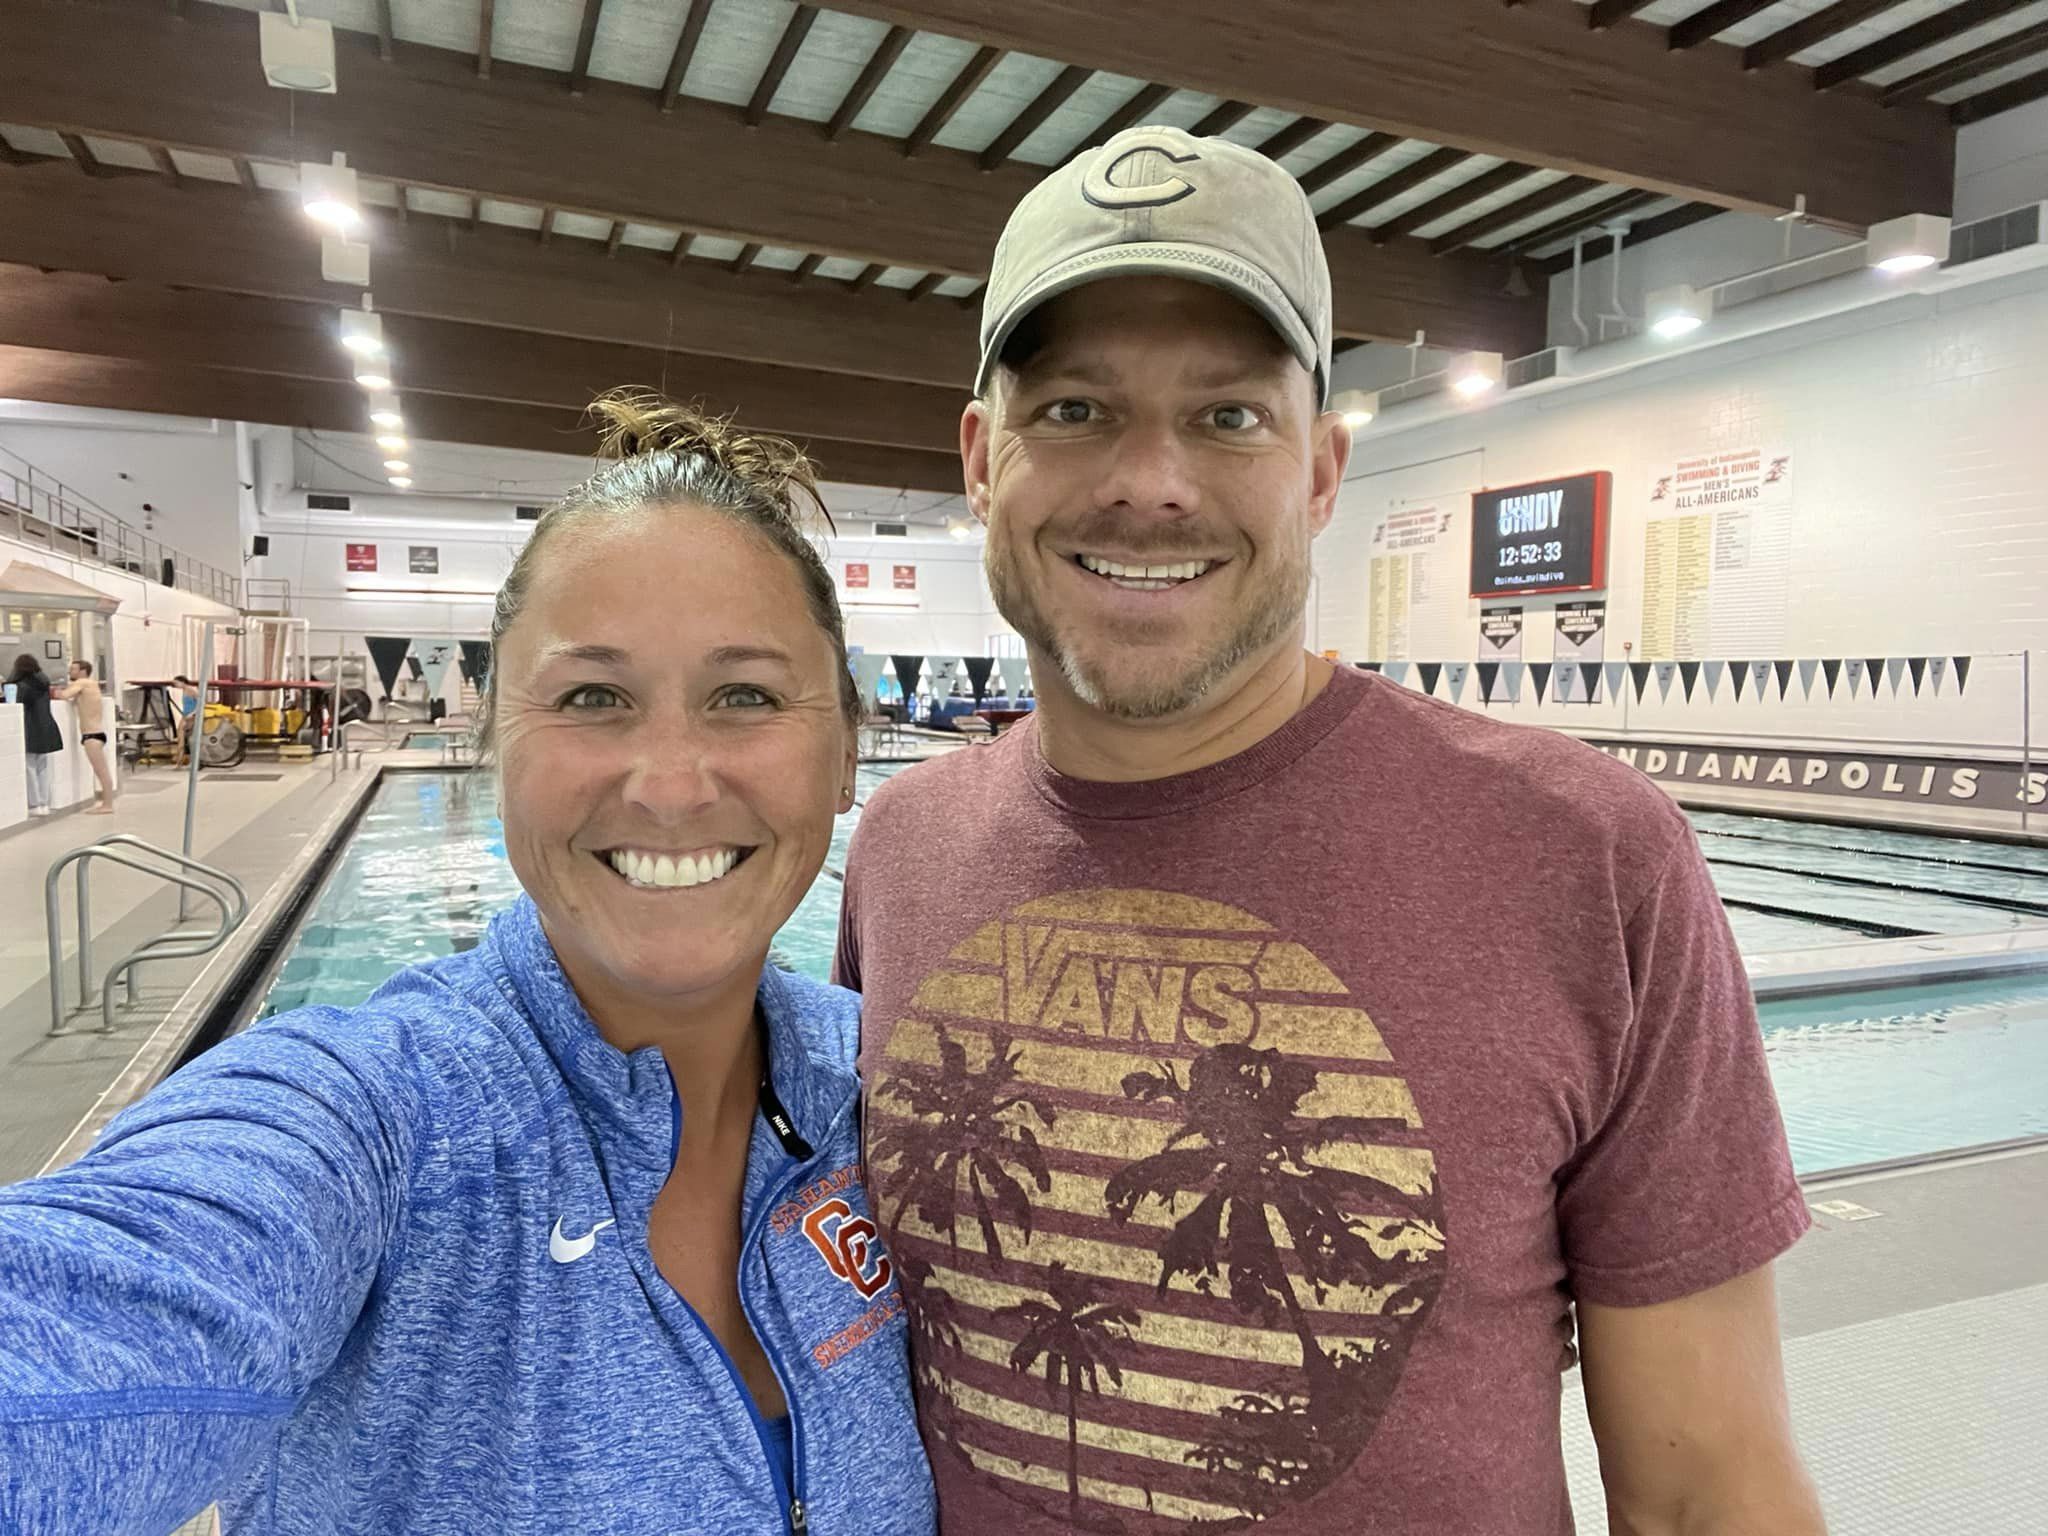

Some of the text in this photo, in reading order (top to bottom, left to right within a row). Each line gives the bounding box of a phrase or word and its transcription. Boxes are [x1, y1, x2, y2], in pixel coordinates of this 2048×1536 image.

[1082, 132, 1201, 210] C
[1731, 460, 1761, 475] DIVING
[1675, 486, 1760, 510] ALL-AMERICANS
[1601, 747, 1980, 799] NDIANAPOLIS
[1003, 917, 1260, 1049] VANS
[772, 1115, 791, 1136] NIKE
[802, 1198, 893, 1302] CC
